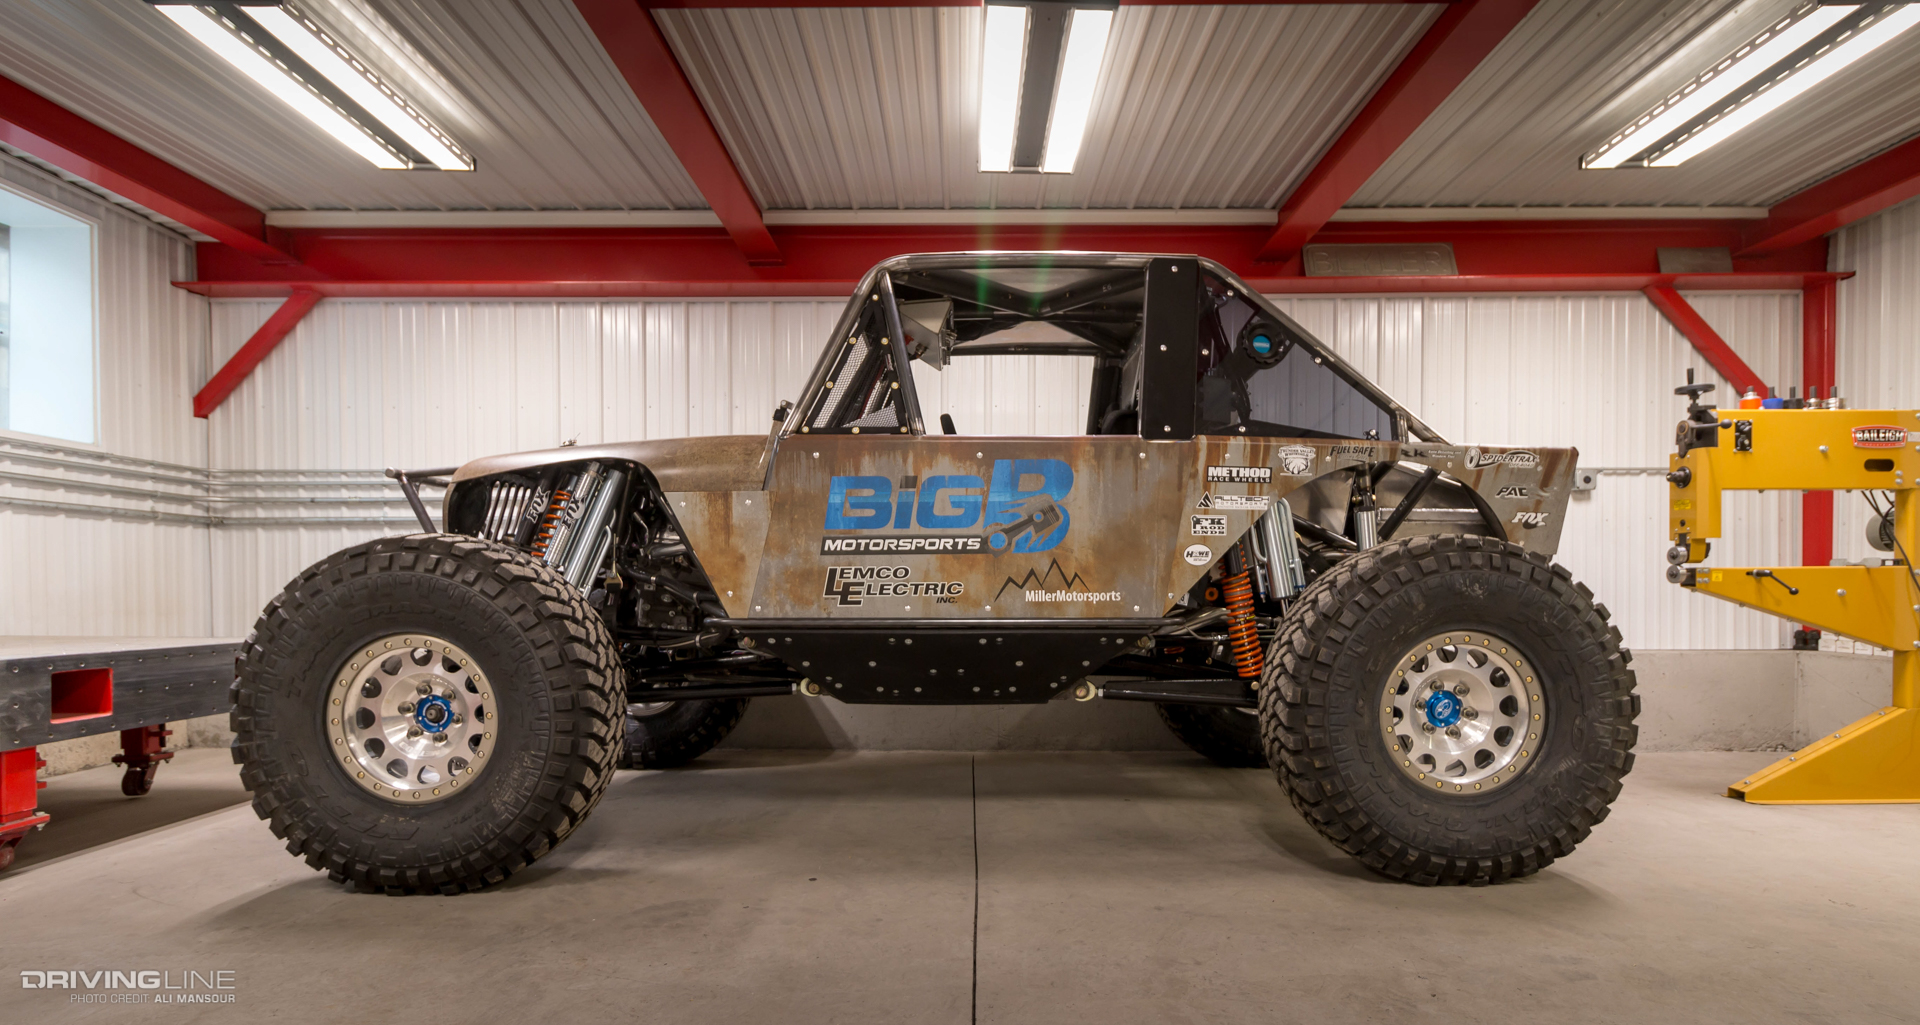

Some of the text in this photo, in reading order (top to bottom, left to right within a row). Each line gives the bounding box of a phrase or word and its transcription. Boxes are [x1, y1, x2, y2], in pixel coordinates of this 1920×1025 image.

[1856, 429, 1904, 441] BAILEIGH
[1330, 445, 1353, 457] FUEL
[1352, 446, 1376, 458] SAFE
[1481, 454, 1537, 463] SPIDERTRAX
[1207, 467, 1271, 478] METHOD
[1495, 487, 1529, 498] PAC
[526, 486, 551, 523] FOX
[561, 491, 587, 531] FOX
[1191, 515, 1225, 529] FK
[1512, 512, 1550, 528] FOX
[823, 537, 982, 552] MOTORSPORTS
[823, 566, 910, 598] LEMCO
[837, 580, 964, 608] ELECTRIC
[936, 596, 958, 604] INC.
[1024, 589, 1122, 605] MillerMotorsports
